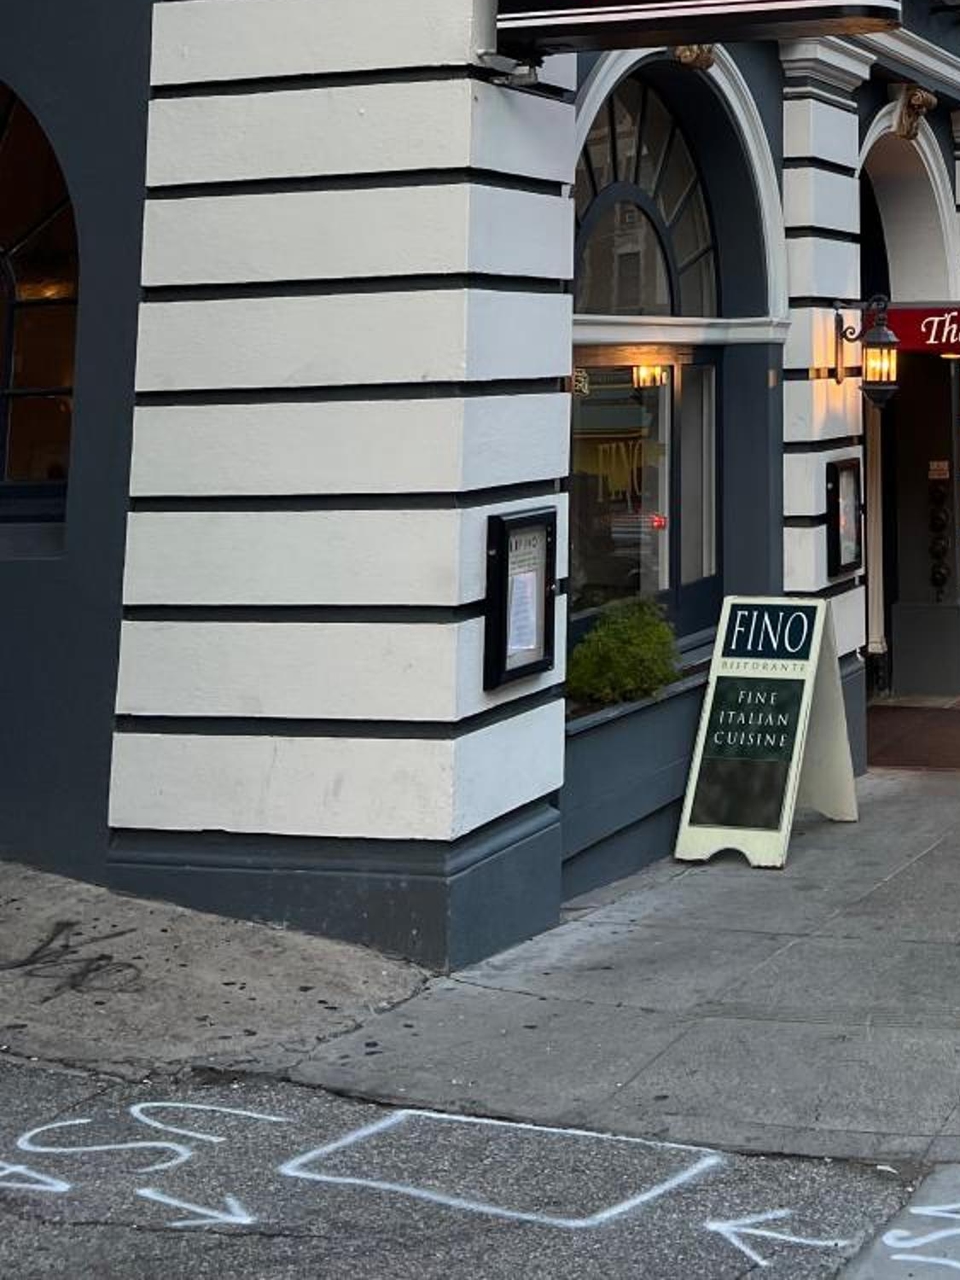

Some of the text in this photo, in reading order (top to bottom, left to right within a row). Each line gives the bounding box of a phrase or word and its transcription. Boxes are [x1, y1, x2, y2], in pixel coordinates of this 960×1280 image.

[730, 610, 809, 653] FINO
[738, 690, 779, 705] FINE
[719, 710, 790, 726] ITALIAN
[714, 731, 788, 747] CUISINE
